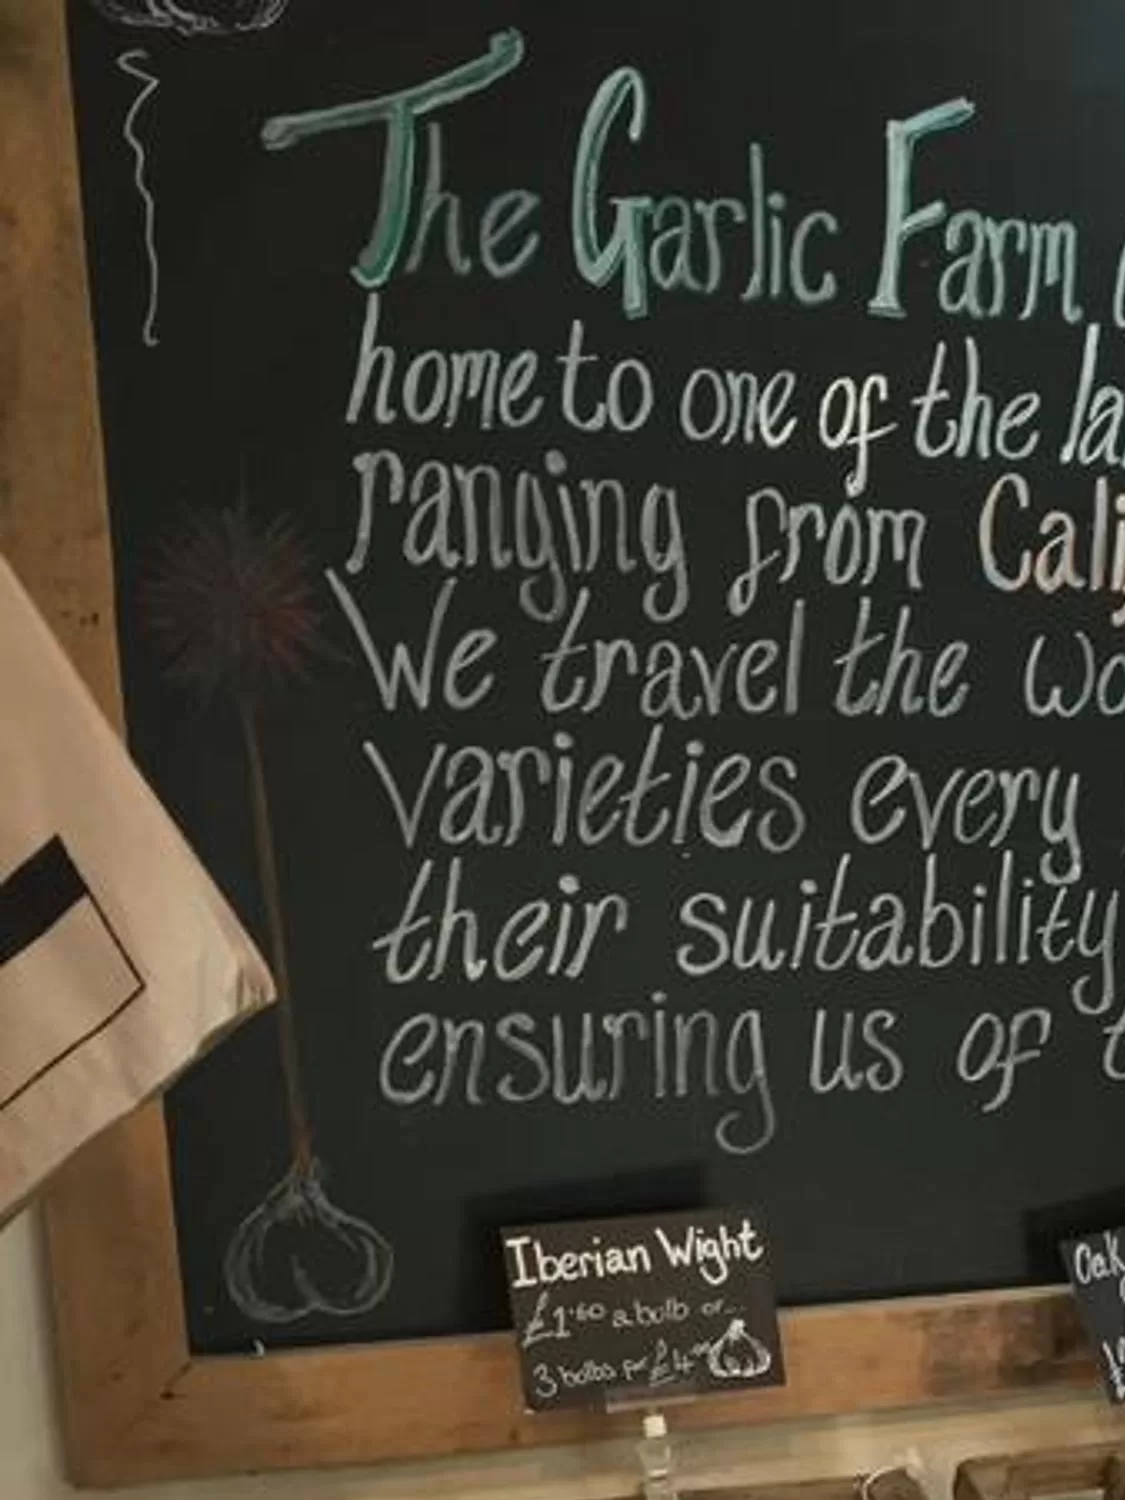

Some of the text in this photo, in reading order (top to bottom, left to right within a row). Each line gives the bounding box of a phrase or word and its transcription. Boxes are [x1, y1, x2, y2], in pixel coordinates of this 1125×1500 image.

[261, 27, 540, 289] The
[572, 66, 838, 320] Garlic
[867, 95, 1084, 324] Farm
[345, 292, 544, 431] home
[558, 320, 654, 432] to
[680, 369, 797, 448] one
[818, 373, 899, 496] of
[911, 336, 1041, 461] the
[345, 450, 690, 622] ranging
[730, 488, 925, 618] from
[326, 566, 497, 712] We
[540, 585, 805, 721] travel
[834, 598, 970, 717] the
[363, 724, 806, 853] varieties
[851, 754, 1082, 884] every
[372, 856, 629, 983] their
[676, 851, 1121, 1015] suitability
[379, 991, 775, 1153] ensuring
[808, 1008, 905, 1093] us
[956, 1008, 1051, 1111] of
[505, 1219, 764, 1288] Iberian Wight
[635, 1299, 690, 1325] bulb
[533, 1363, 558, 1398] 3
